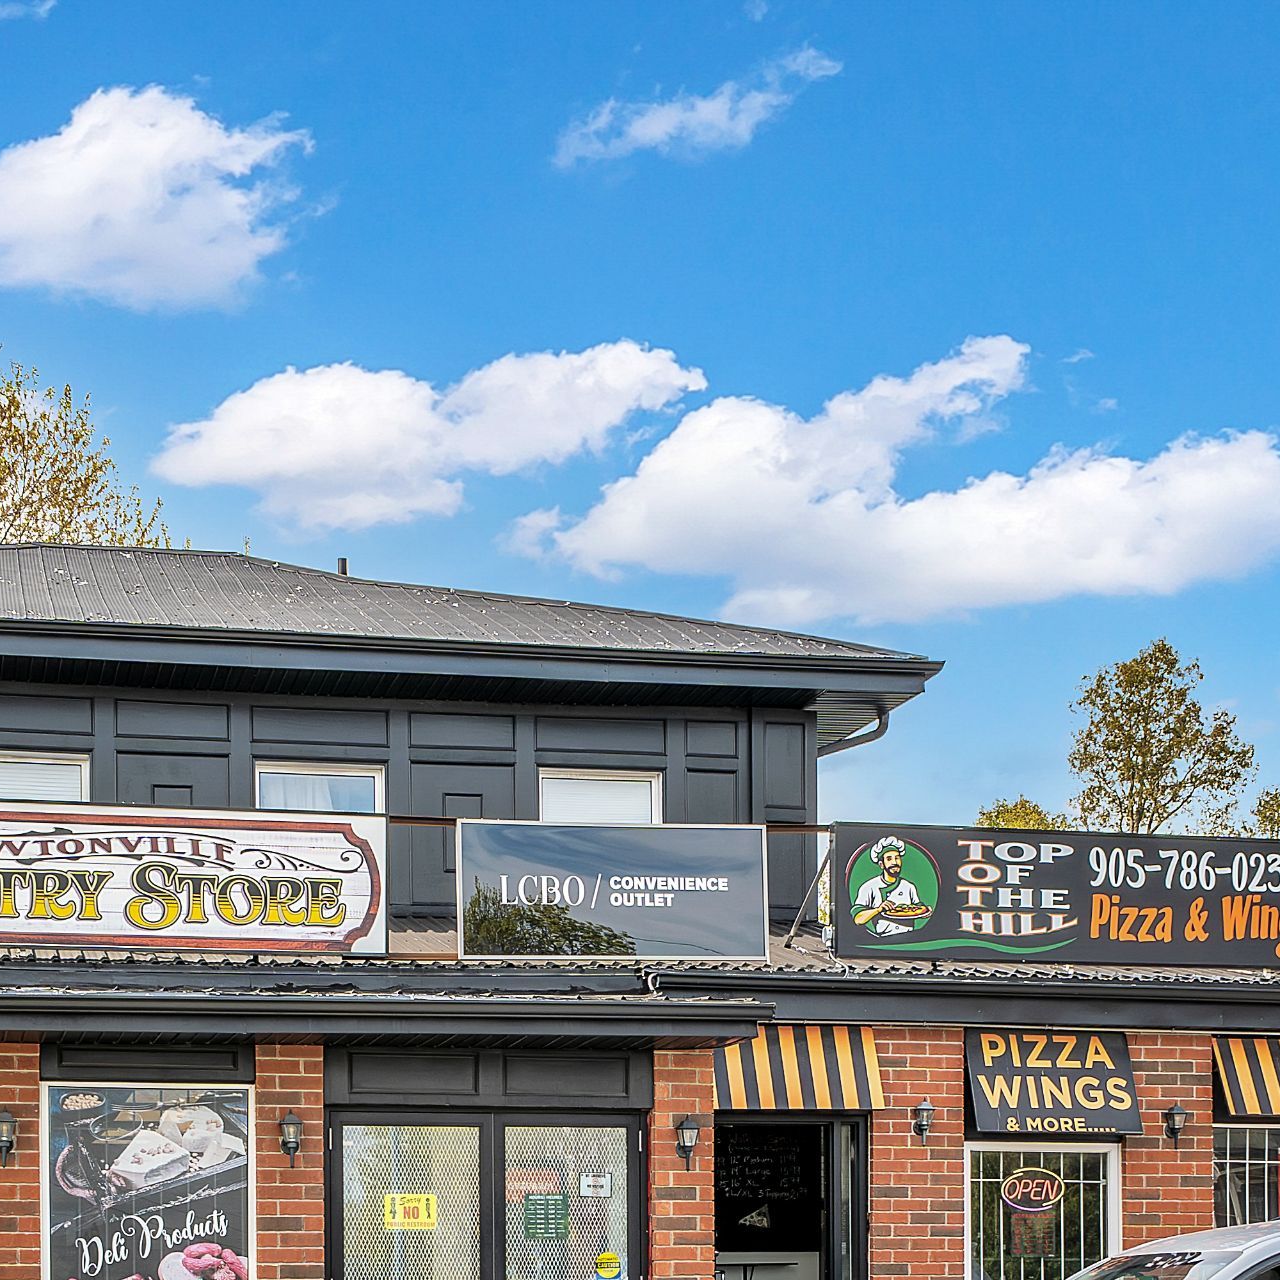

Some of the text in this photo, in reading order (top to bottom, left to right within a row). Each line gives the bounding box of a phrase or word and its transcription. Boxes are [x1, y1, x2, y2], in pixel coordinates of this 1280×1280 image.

[957, 839, 1075, 864] TOP
[609, 876, 729, 891] CONVENIENCE
[957, 863, 1035, 885] OF
[124, 861, 346, 930] STORE
[499, 874, 585, 906] LCBO
[609, 893, 674, 907] OUTLET
[956, 885, 1071, 910] THE
[956, 910, 1078, 936] HILL
[1089, 893, 1173, 943] Pizza
[1184, 896, 1209, 942] &
[980, 1033, 1116, 1070] PIZZA
[977, 1074, 1132, 1111] WINGS
[1006, 1117, 1020, 1132] &
[1005, 1179, 1059, 1200] OPEN
[403, 1206, 419, 1219] NO
[75, 1209, 229, 1277] Deli Products
